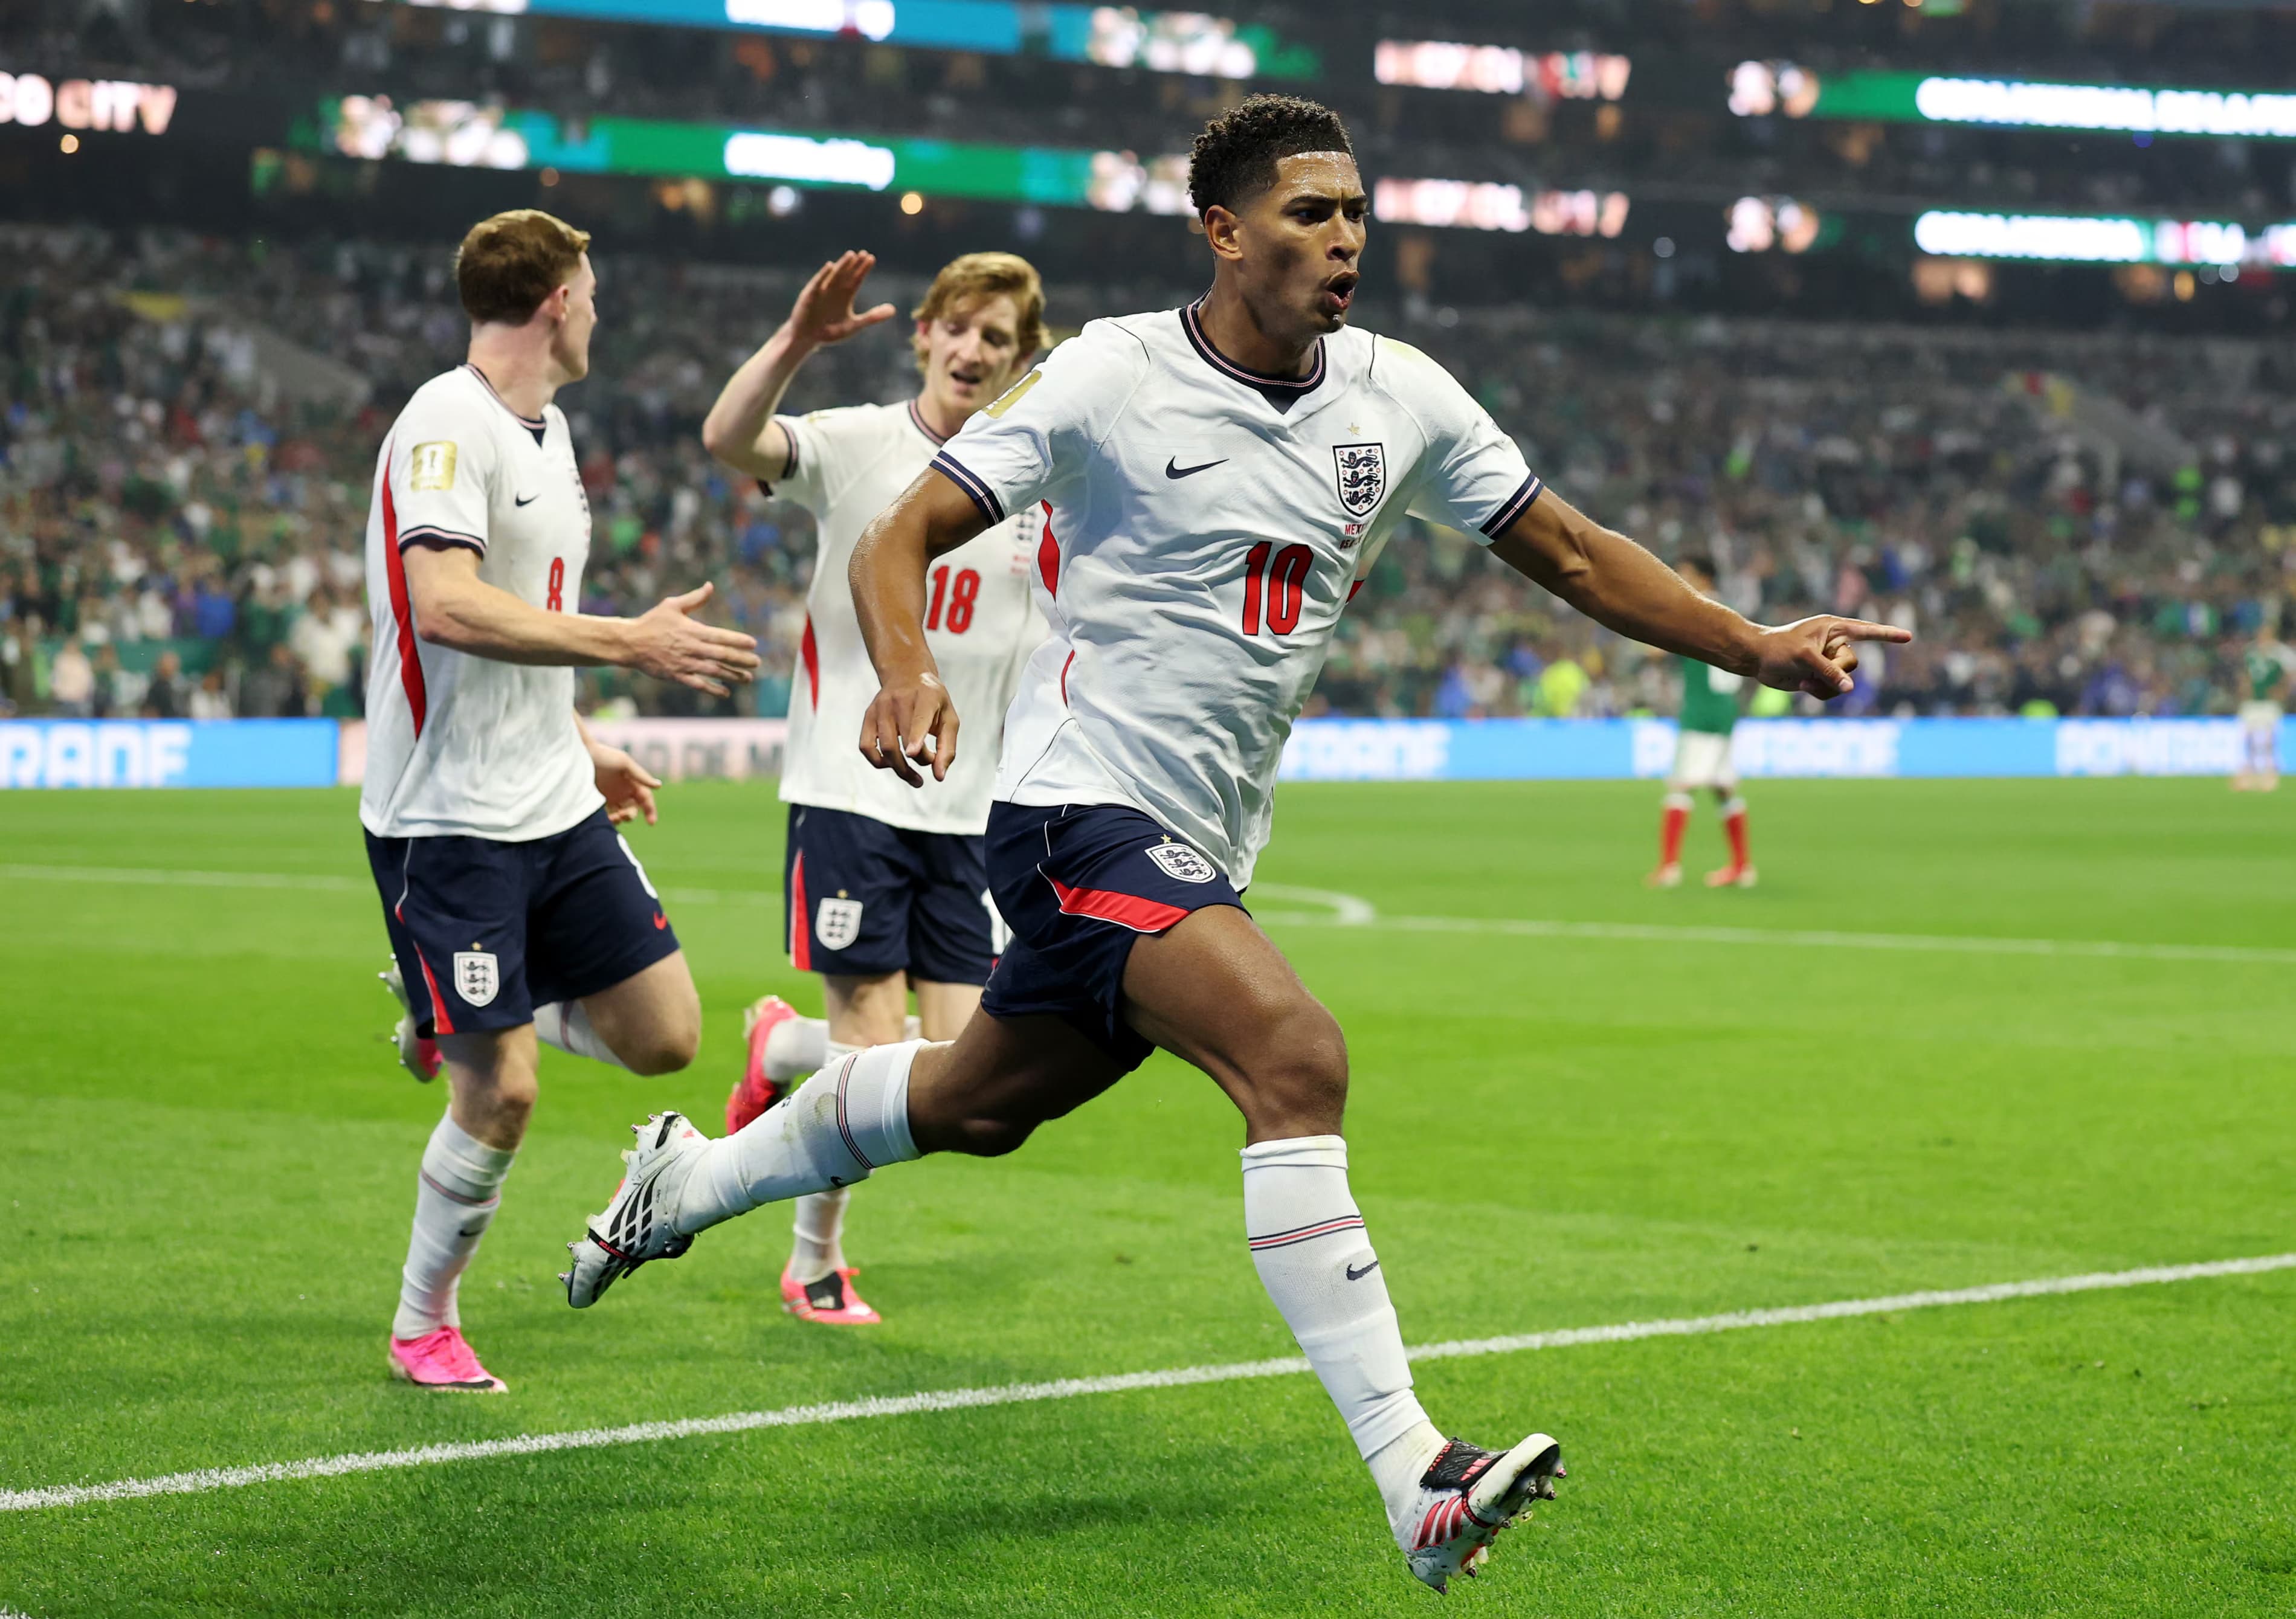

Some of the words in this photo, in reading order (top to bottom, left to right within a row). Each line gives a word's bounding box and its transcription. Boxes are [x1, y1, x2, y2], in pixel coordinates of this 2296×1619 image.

[547, 557, 564, 612] 8
[927, 565, 980, 634] 18
[1242, 541, 1314, 635] 10
